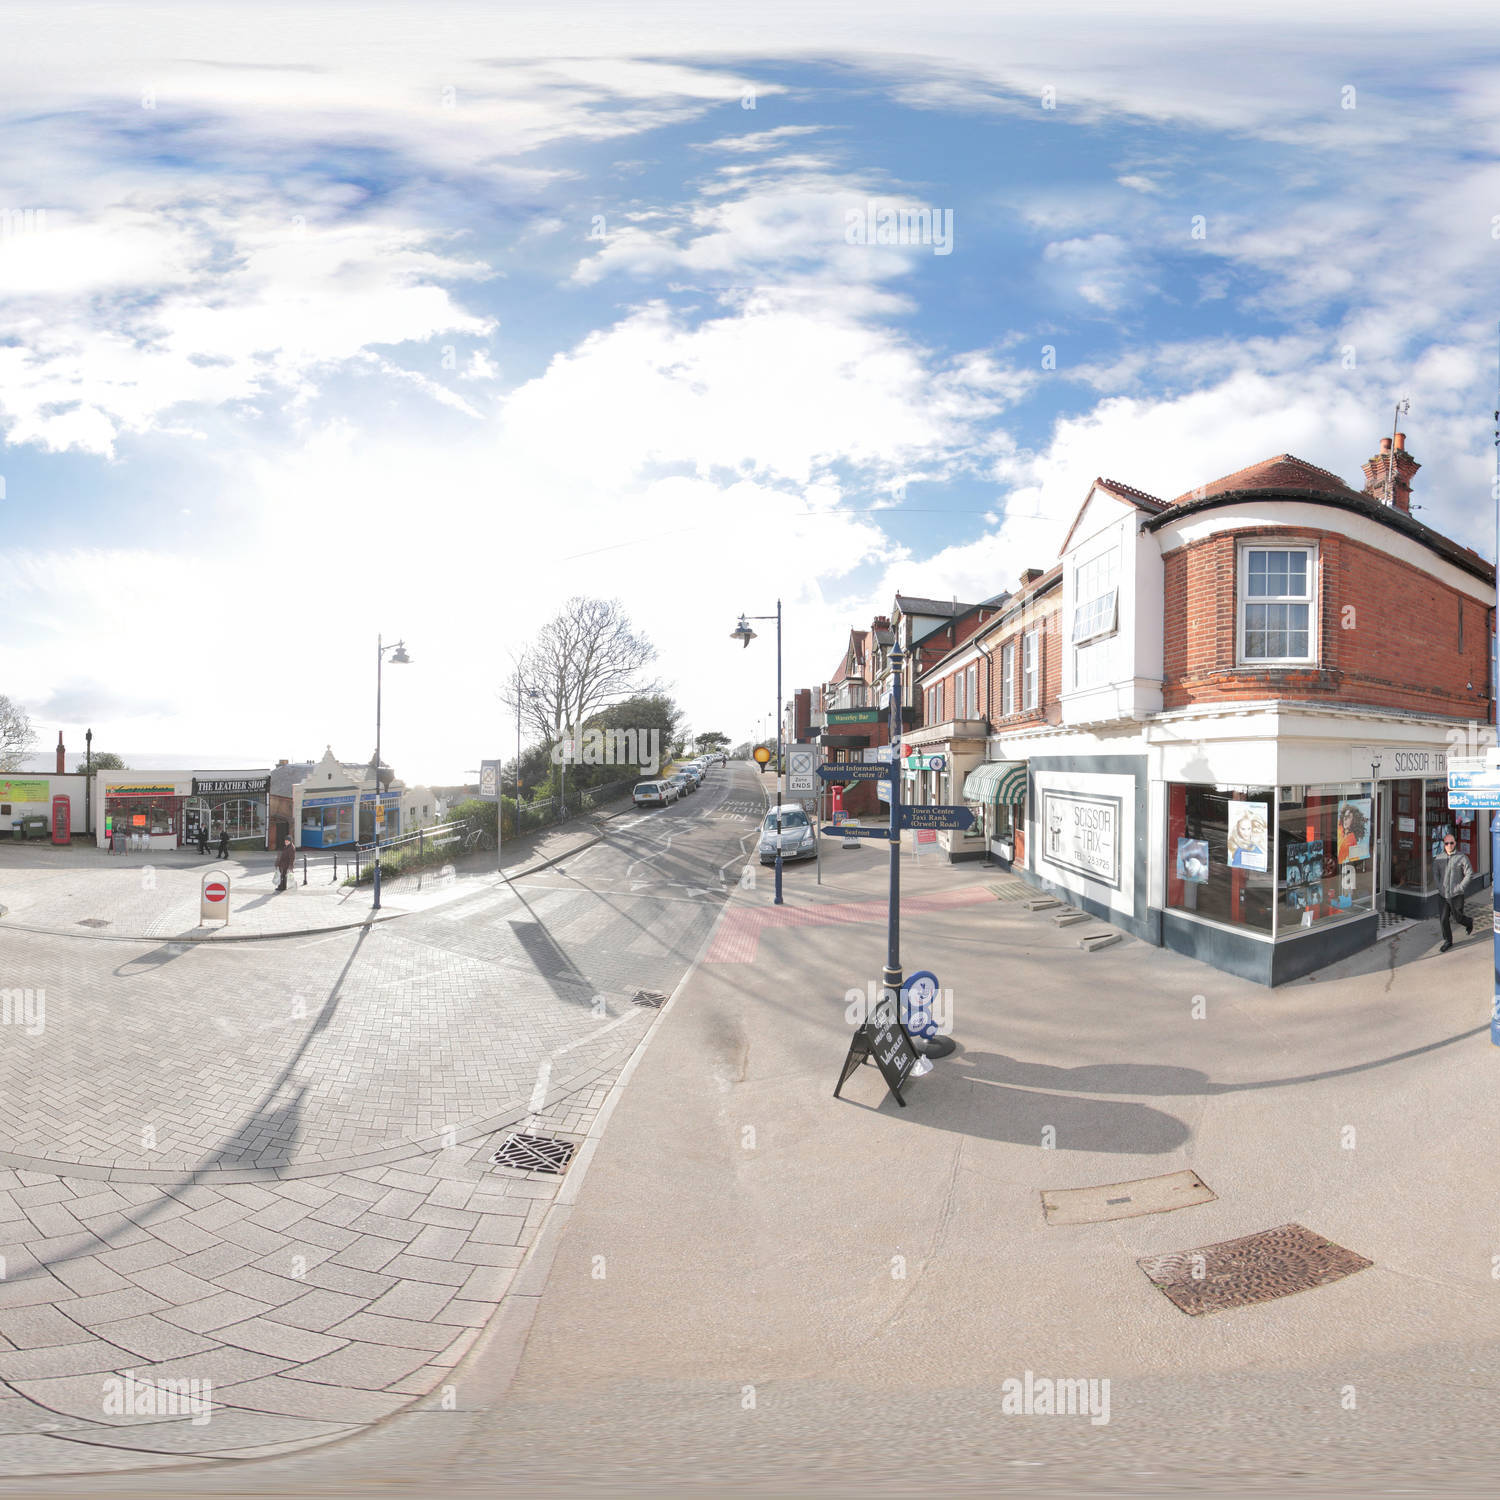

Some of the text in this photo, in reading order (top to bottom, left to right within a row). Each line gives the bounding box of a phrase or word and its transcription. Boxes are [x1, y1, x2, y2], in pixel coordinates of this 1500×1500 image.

[1395, 752, 1429, 772] SCISSOR
[198, 780, 267, 791] THE LEATHER SHOP
[940, 820, 960, 828] Road)
[1074, 806, 1111, 833] SCISSOR
